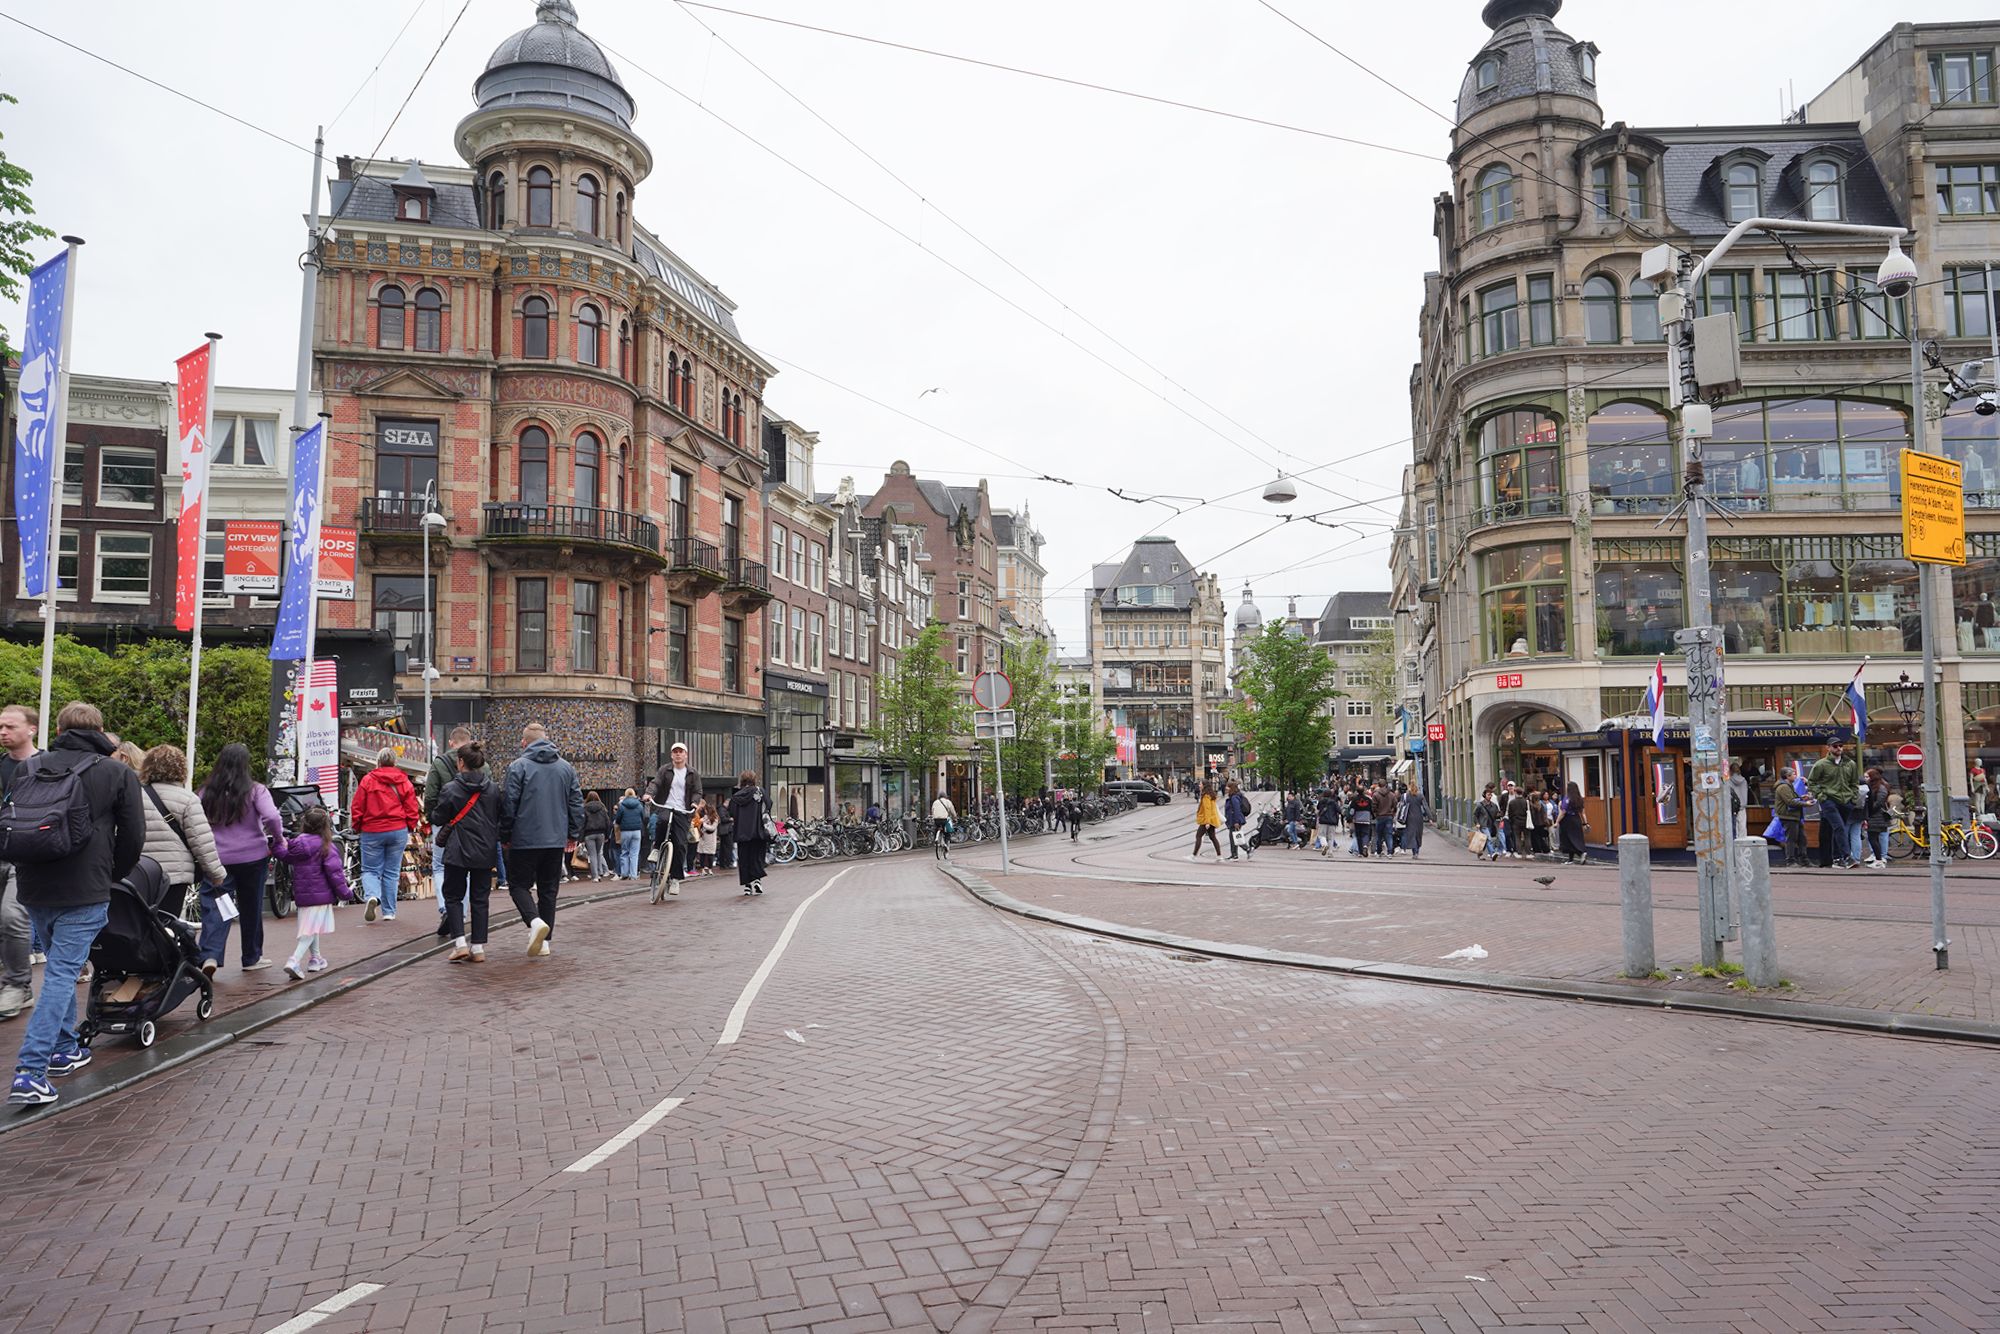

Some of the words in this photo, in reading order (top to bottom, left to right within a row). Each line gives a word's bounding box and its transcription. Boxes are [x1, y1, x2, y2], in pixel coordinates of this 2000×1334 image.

[228, 534, 249, 542] CITY
[1752, 728, 1813, 737] AMSTERDAM
[1209, 754, 1224, 762] BOSS
